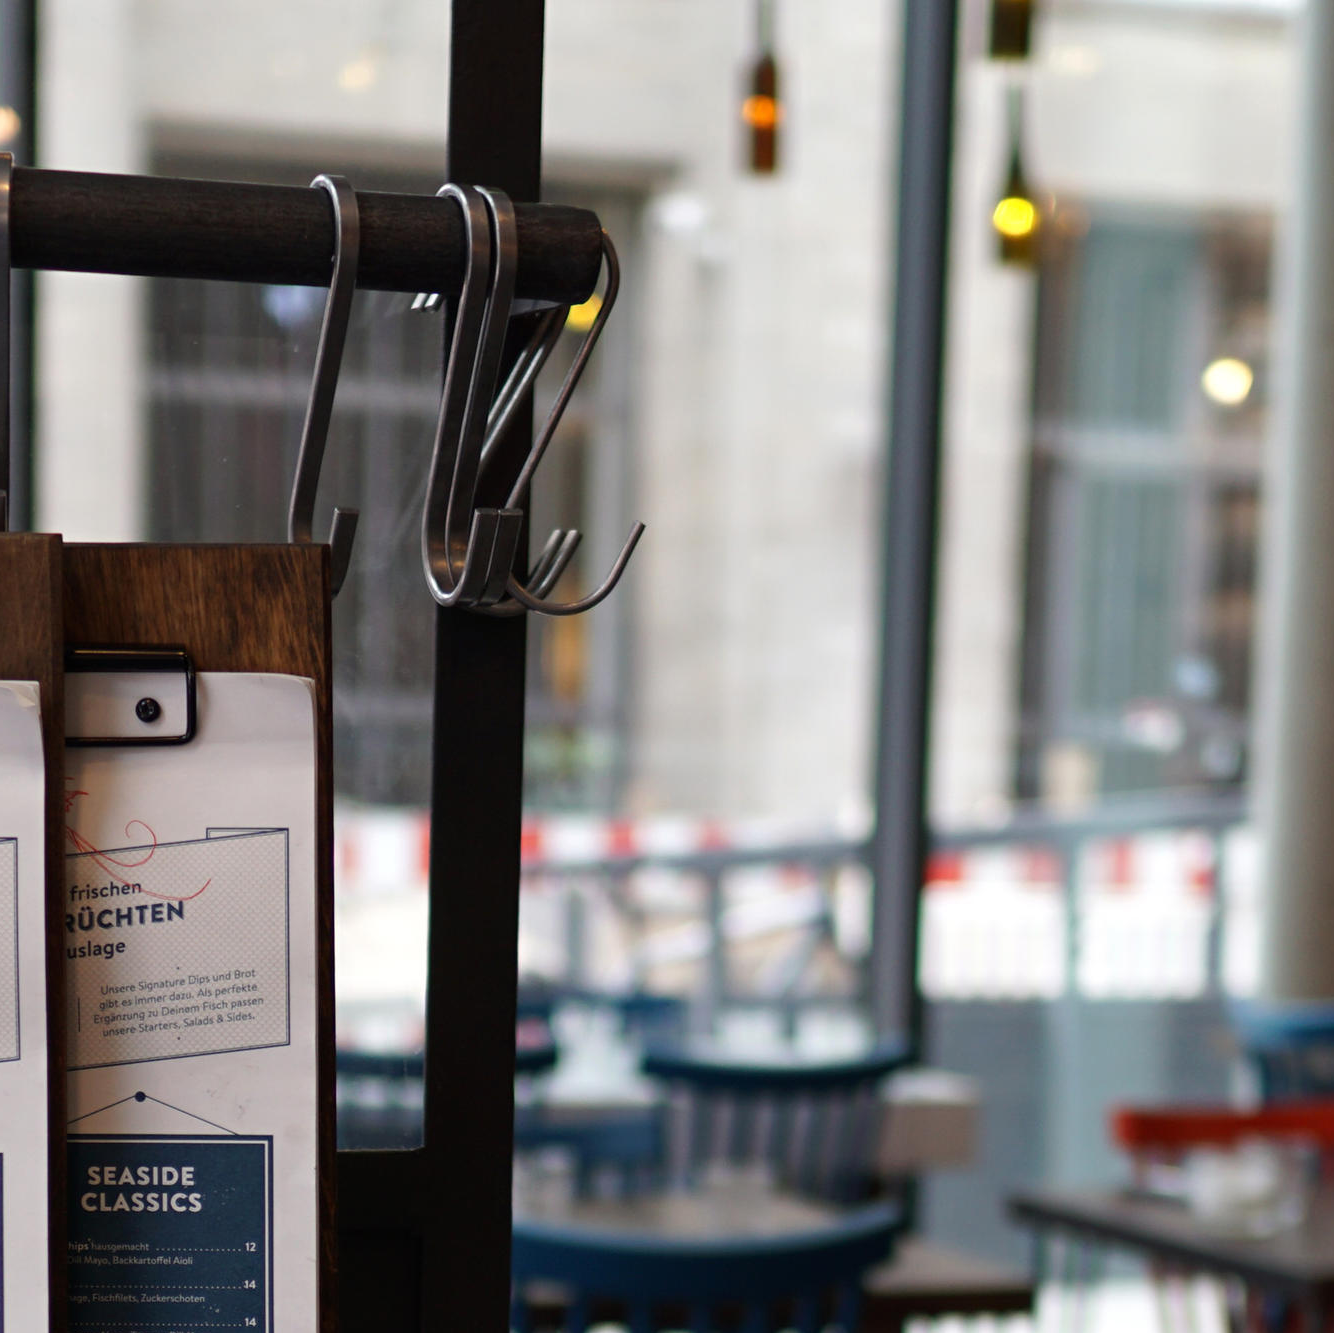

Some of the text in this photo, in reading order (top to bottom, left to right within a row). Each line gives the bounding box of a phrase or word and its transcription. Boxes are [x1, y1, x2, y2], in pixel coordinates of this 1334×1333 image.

[69, 881, 142, 902] frischen
[67, 941, 126, 960] uslage
[87, 1166, 195, 1186] SEASIDE
[81, 1193, 202, 1212] CLASSICS
[91, 1241, 149, 1253] hausgemacht
[245, 1242, 256, 1252] 12
[244, 1317, 257, 1327] 14
